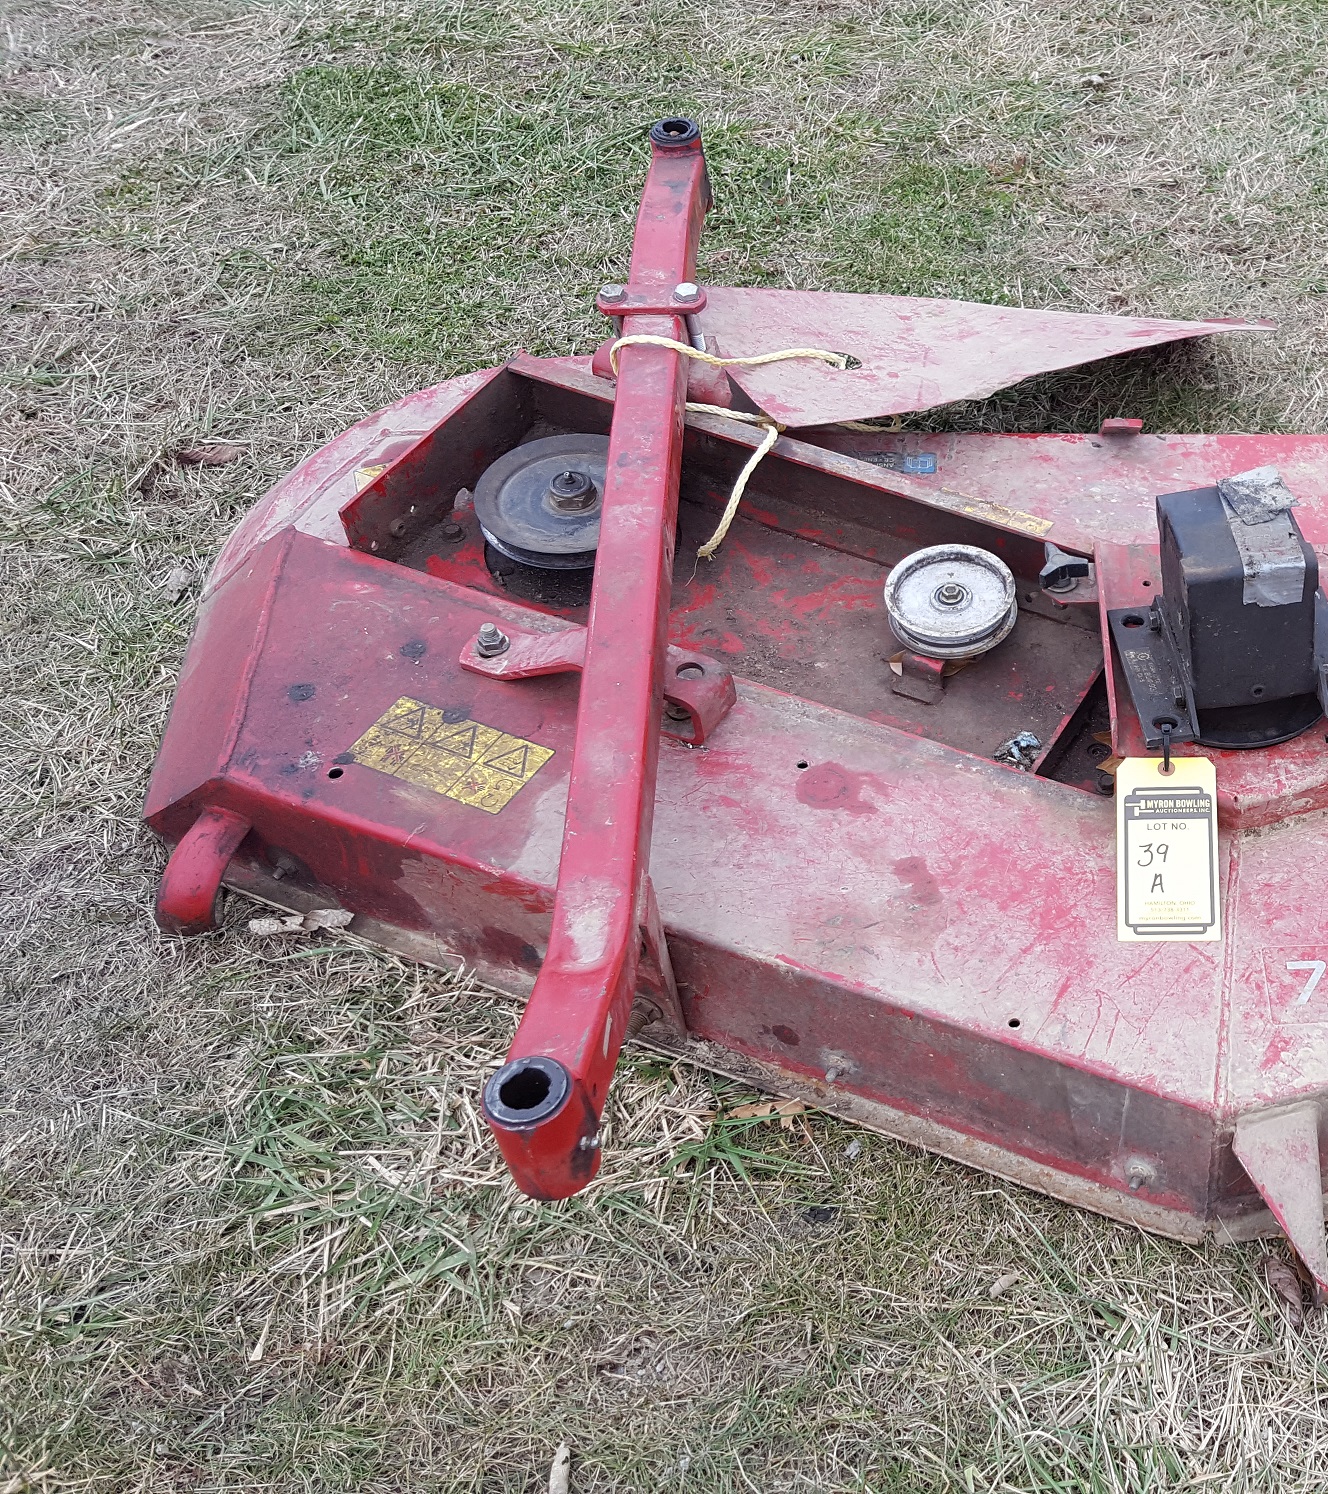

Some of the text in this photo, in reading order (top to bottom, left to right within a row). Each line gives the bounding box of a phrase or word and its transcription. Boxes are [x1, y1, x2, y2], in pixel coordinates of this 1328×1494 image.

[1146, 798, 1211, 809] MYRON BOWLING
[1146, 822, 1190, 831] LOT NO.
[1137, 842, 1169, 867] 39
[1150, 873, 1165, 893] A
